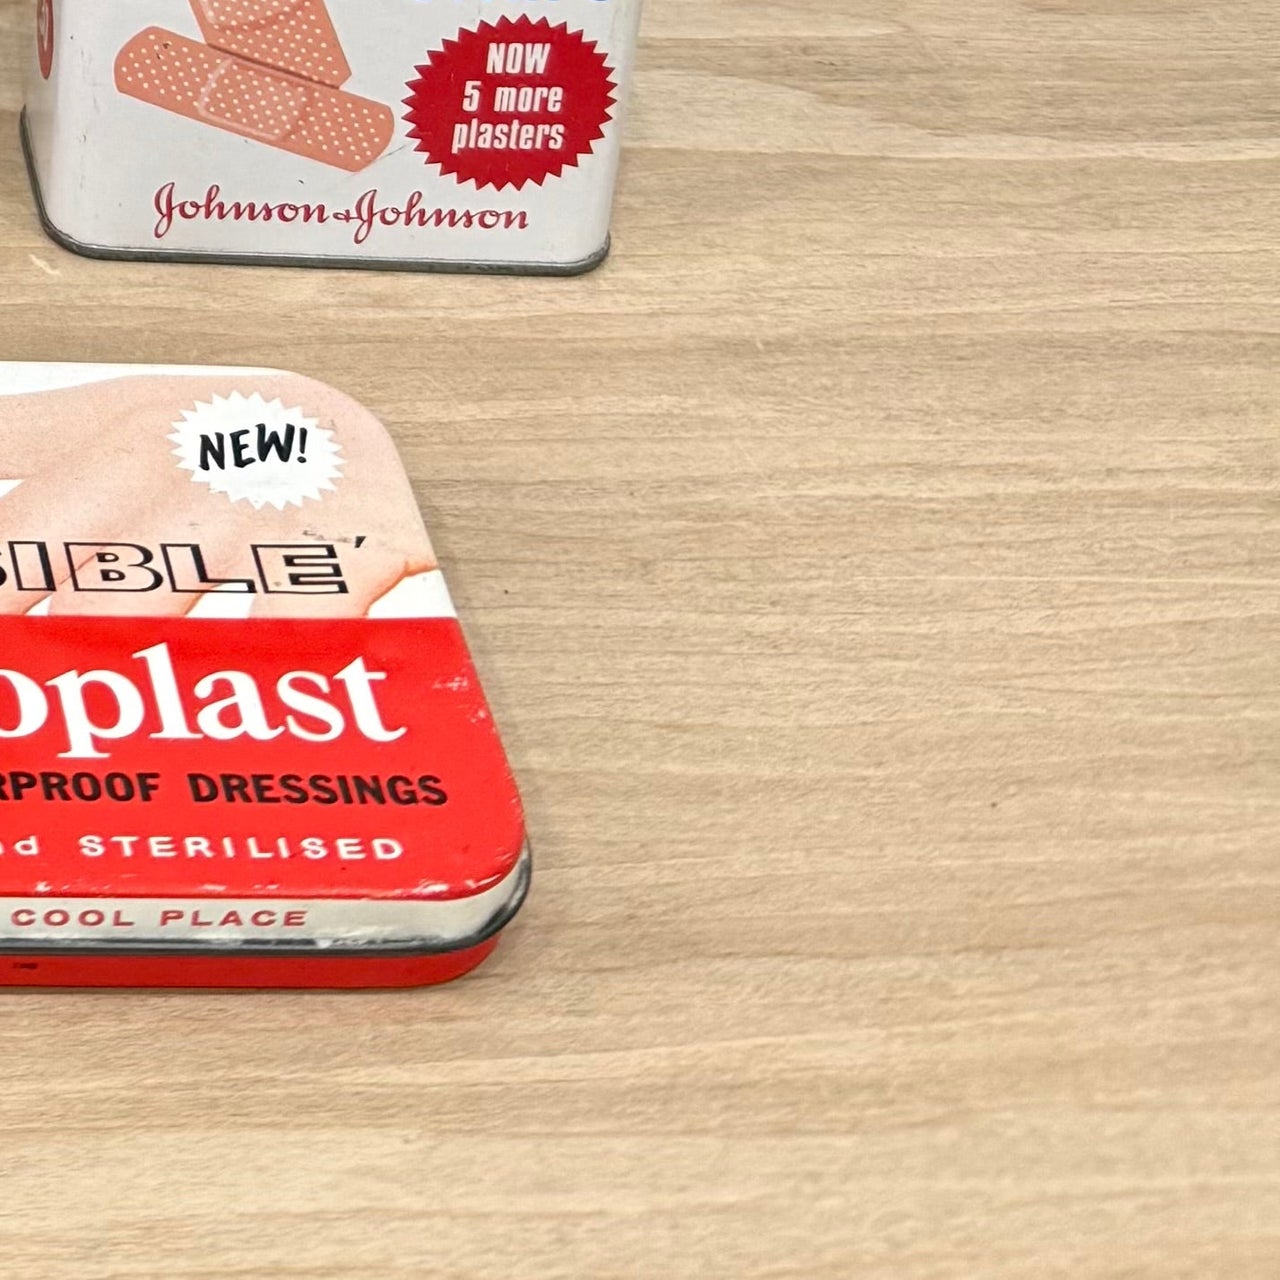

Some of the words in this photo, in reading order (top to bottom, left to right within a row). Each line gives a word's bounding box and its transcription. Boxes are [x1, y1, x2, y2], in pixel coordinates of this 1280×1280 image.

[486, 42, 551, 75] NOW
[463, 80, 479, 112] 5
[494, 86, 563, 113] more
[451, 119, 566, 154] plasters
[153, 180, 327, 239] Johnson
[352, 188, 529, 245] Johnson
[198, 421, 309, 472] NEW!
[186, 771, 449, 807] DRESSINGS
[78, 834, 405, 860] STERILISED
[10, 907, 136, 927] COOL
[159, 909, 309, 928] PLACE
